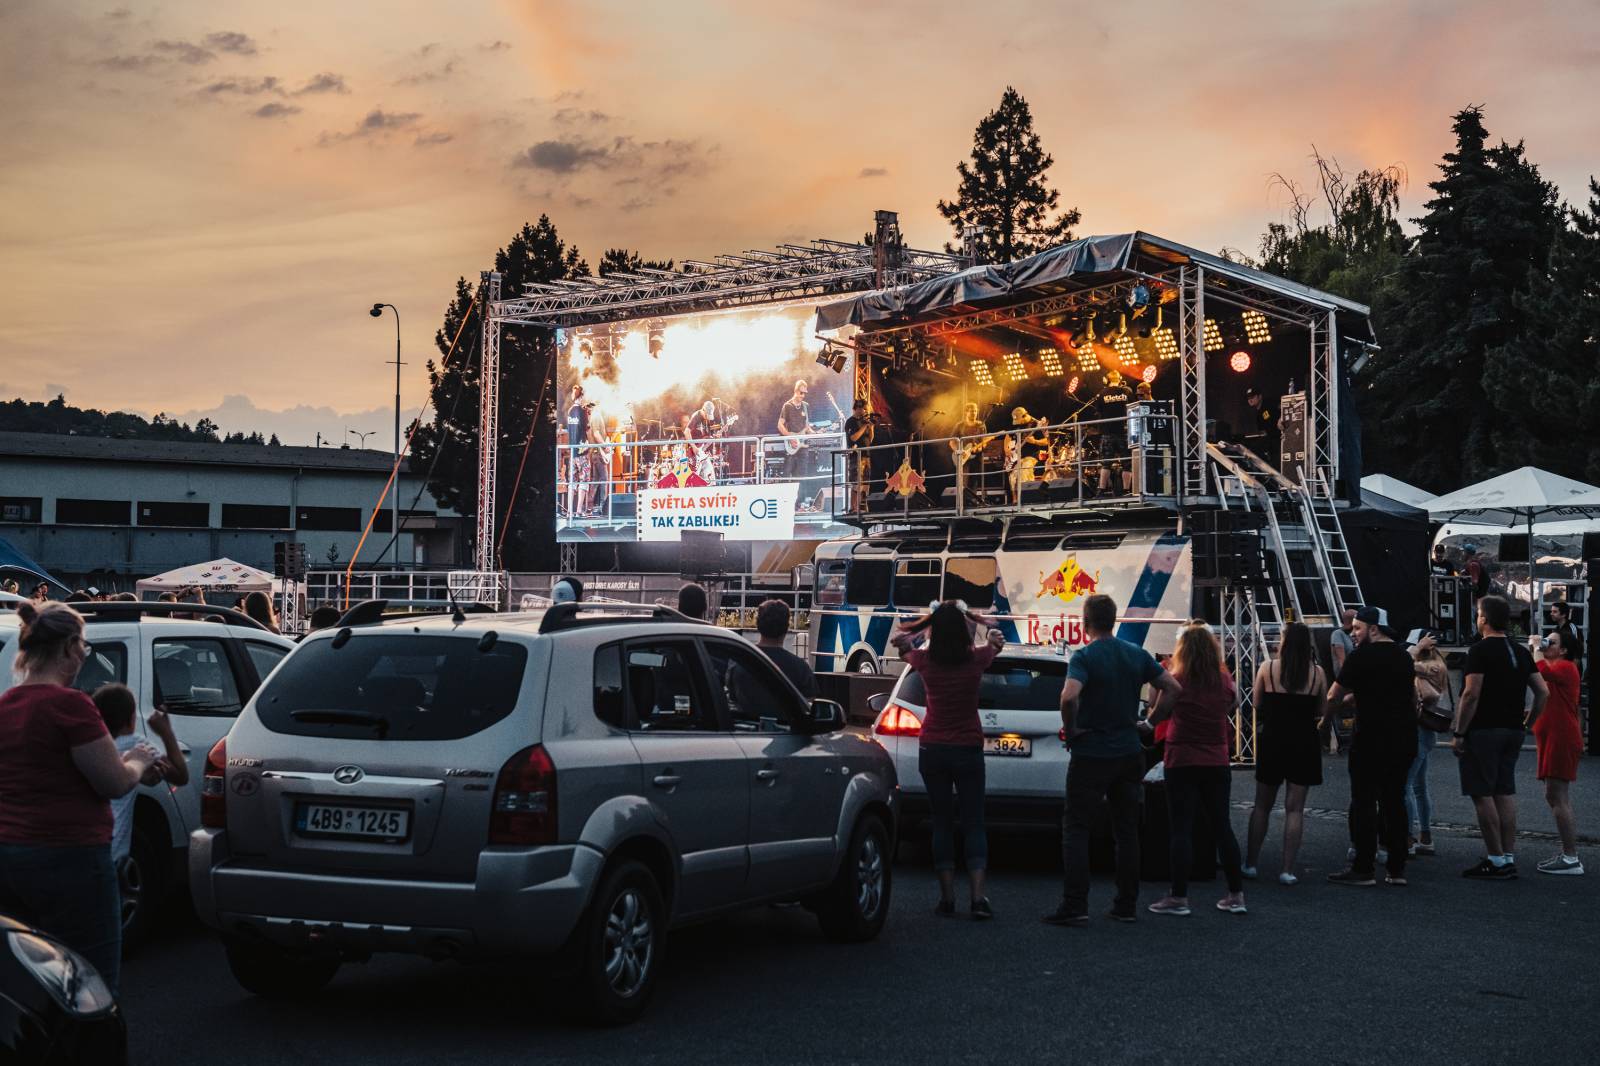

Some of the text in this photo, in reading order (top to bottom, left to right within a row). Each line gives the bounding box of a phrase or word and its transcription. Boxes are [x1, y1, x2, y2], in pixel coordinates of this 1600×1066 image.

[651, 493, 738, 509] SVĚTLA SVÍTÍ?
[651, 515, 740, 527] TAK ZABLIKEJ!
[994, 739, 1025, 752] 3824
[310, 808, 401, 834] 4B9 1245
